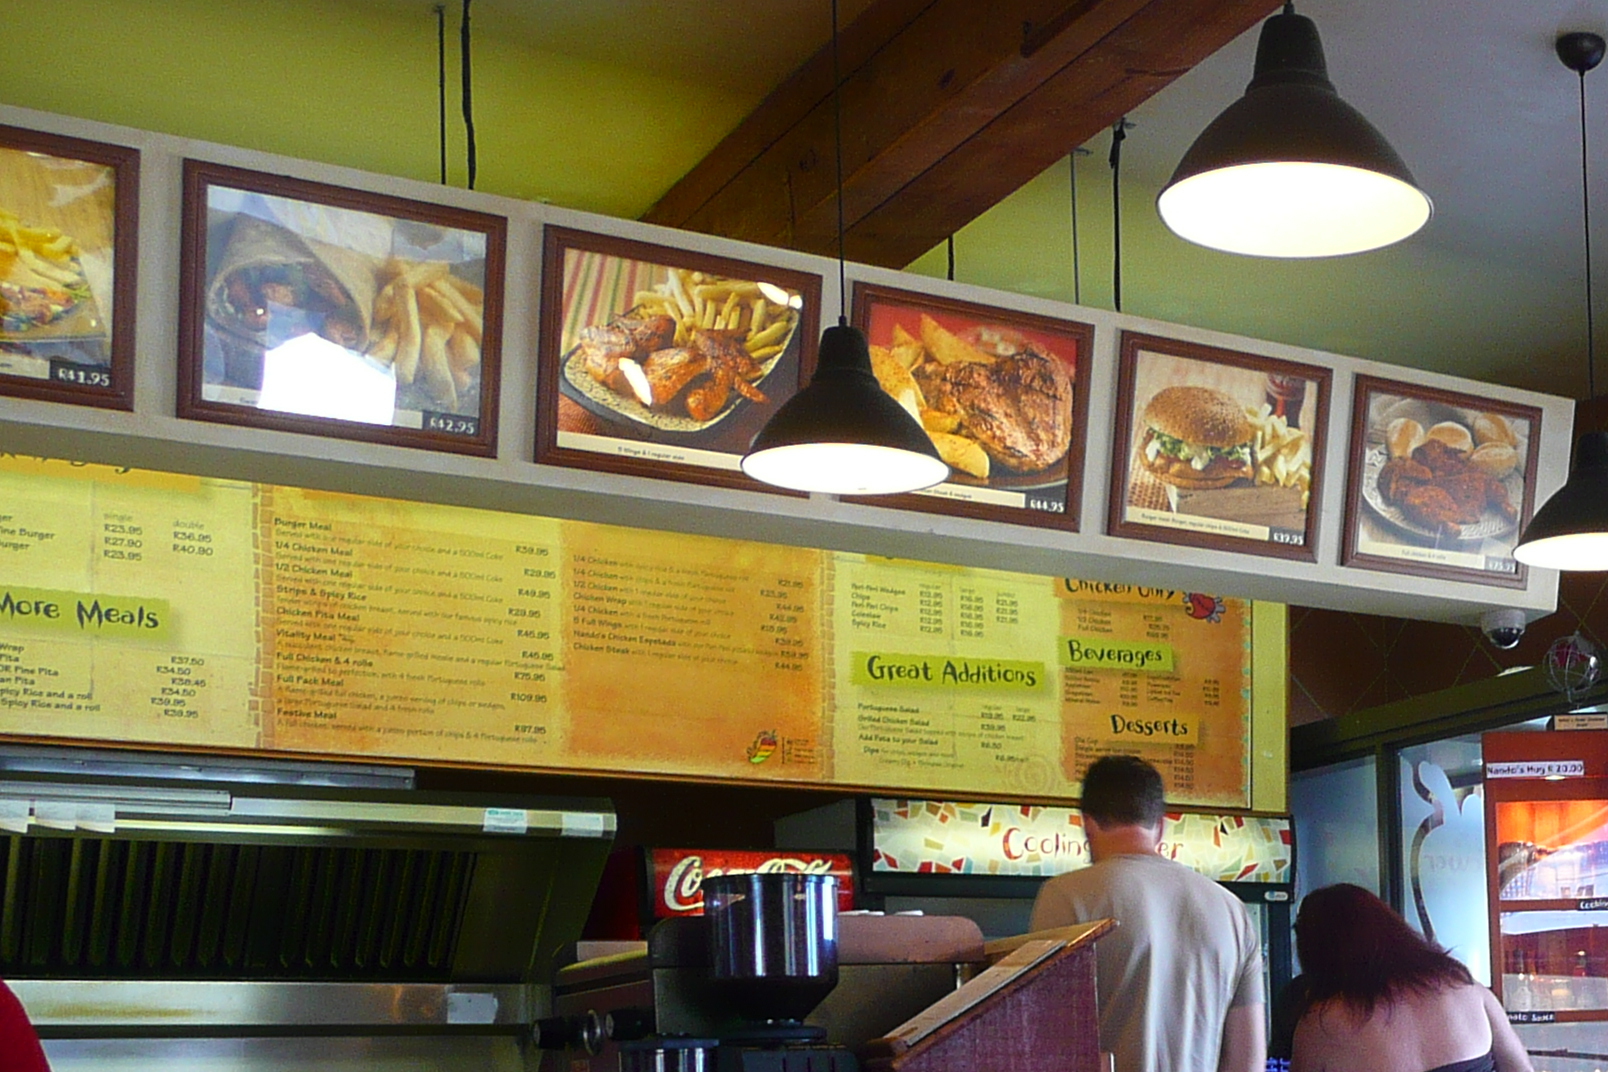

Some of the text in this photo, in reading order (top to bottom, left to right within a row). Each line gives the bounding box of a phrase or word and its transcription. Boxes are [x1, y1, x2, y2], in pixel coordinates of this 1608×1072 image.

[59, 368, 110, 387] R41.95
[274, 517, 332, 531] Burger Meal
[19, 528, 55, 542] Burger
[275, 541, 353, 556] 1/4 Chicken Meal
[275, 563, 353, 578] 1/2 Chicken Meal
[276, 585, 307, 596] Strips
[320, 590, 345, 600] Spicy
[348, 592, 367, 600] Rice
[76, 599, 159, 629] Meals
[276, 606, 360, 621] Chicken Pita Meal
[276, 629, 336, 641] Vitality Meal
[277, 652, 294, 660] Full
[296, 653, 332, 663] Chicken
[1067, 639, 1162, 667] Beverages
[867, 655, 934, 682] Great
[942, 660, 1036, 687] Additions
[277, 674, 294, 683] Full
[297, 676, 318, 685] Pack
[322, 678, 344, 687] Meal
[277, 708, 337, 719] Festive Meal
[1110, 714, 1188, 736] Desserts
[1002, 827, 1092, 860] Cooling
